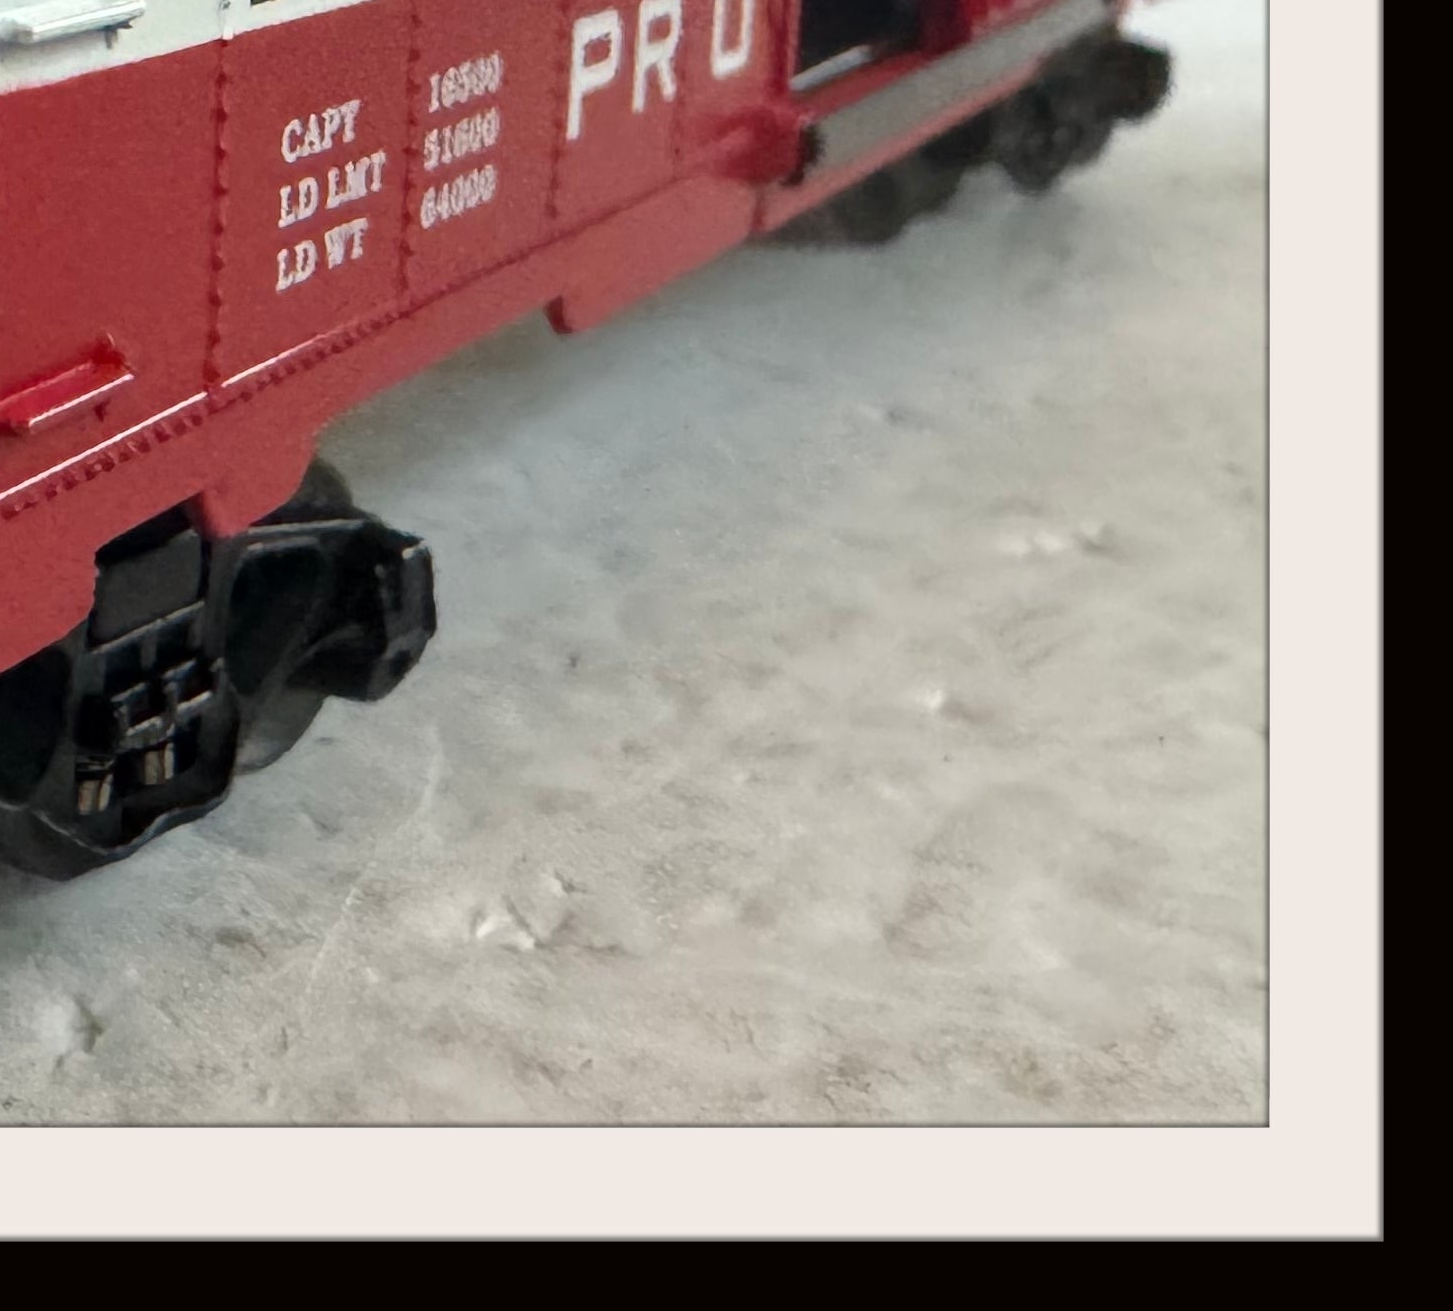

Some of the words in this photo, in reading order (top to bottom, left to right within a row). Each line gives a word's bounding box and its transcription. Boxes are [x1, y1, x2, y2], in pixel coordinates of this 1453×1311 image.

[278, 176, 319, 228] LD
[325, 150, 387, 209] LMT
[275, 239, 318, 293] LD
[324, 217, 370, 270] WT
